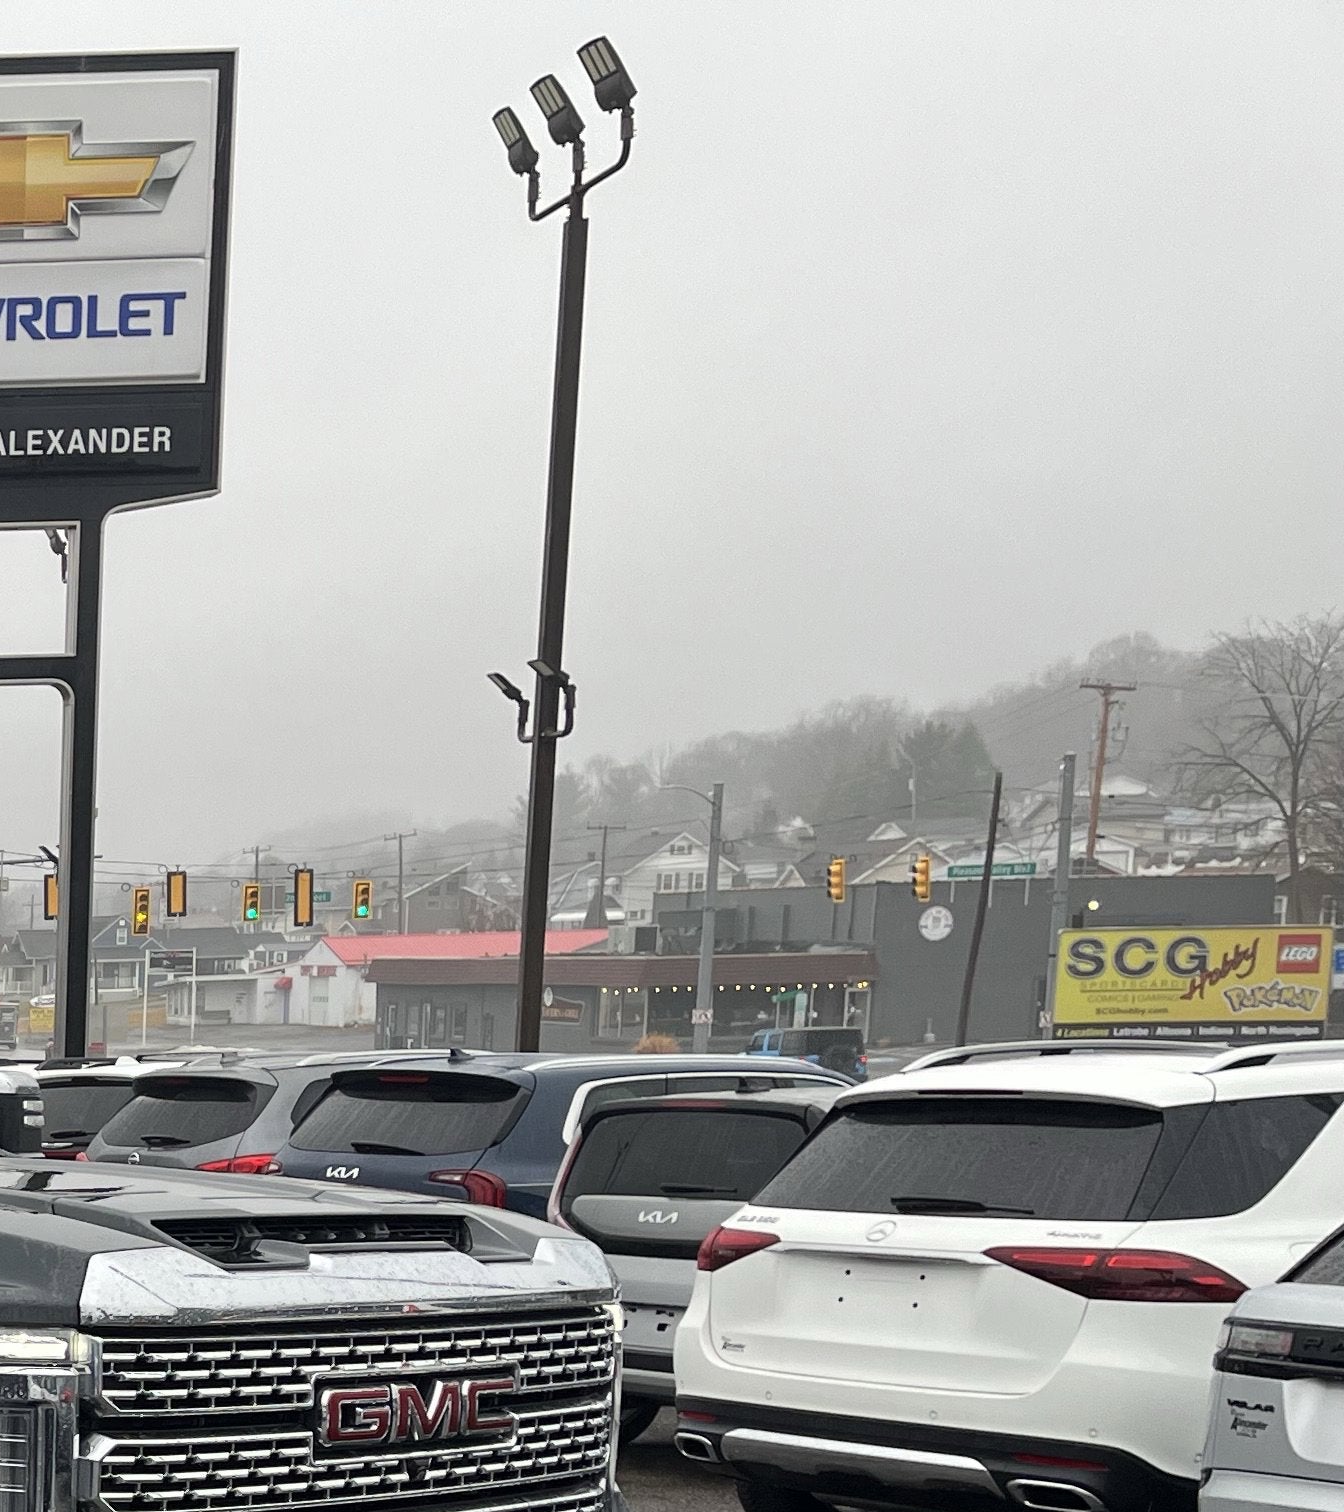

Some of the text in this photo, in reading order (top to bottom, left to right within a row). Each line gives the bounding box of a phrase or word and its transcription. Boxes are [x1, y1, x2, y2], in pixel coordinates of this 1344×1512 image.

[1279, 945, 1319, 962] LEGO
[1066, 936, 1260, 1000] SCG Hobby
[325, 1166, 360, 1179] KIA
[638, 1210, 679, 1224] KIA
[321, 1377, 515, 1447] GMC
